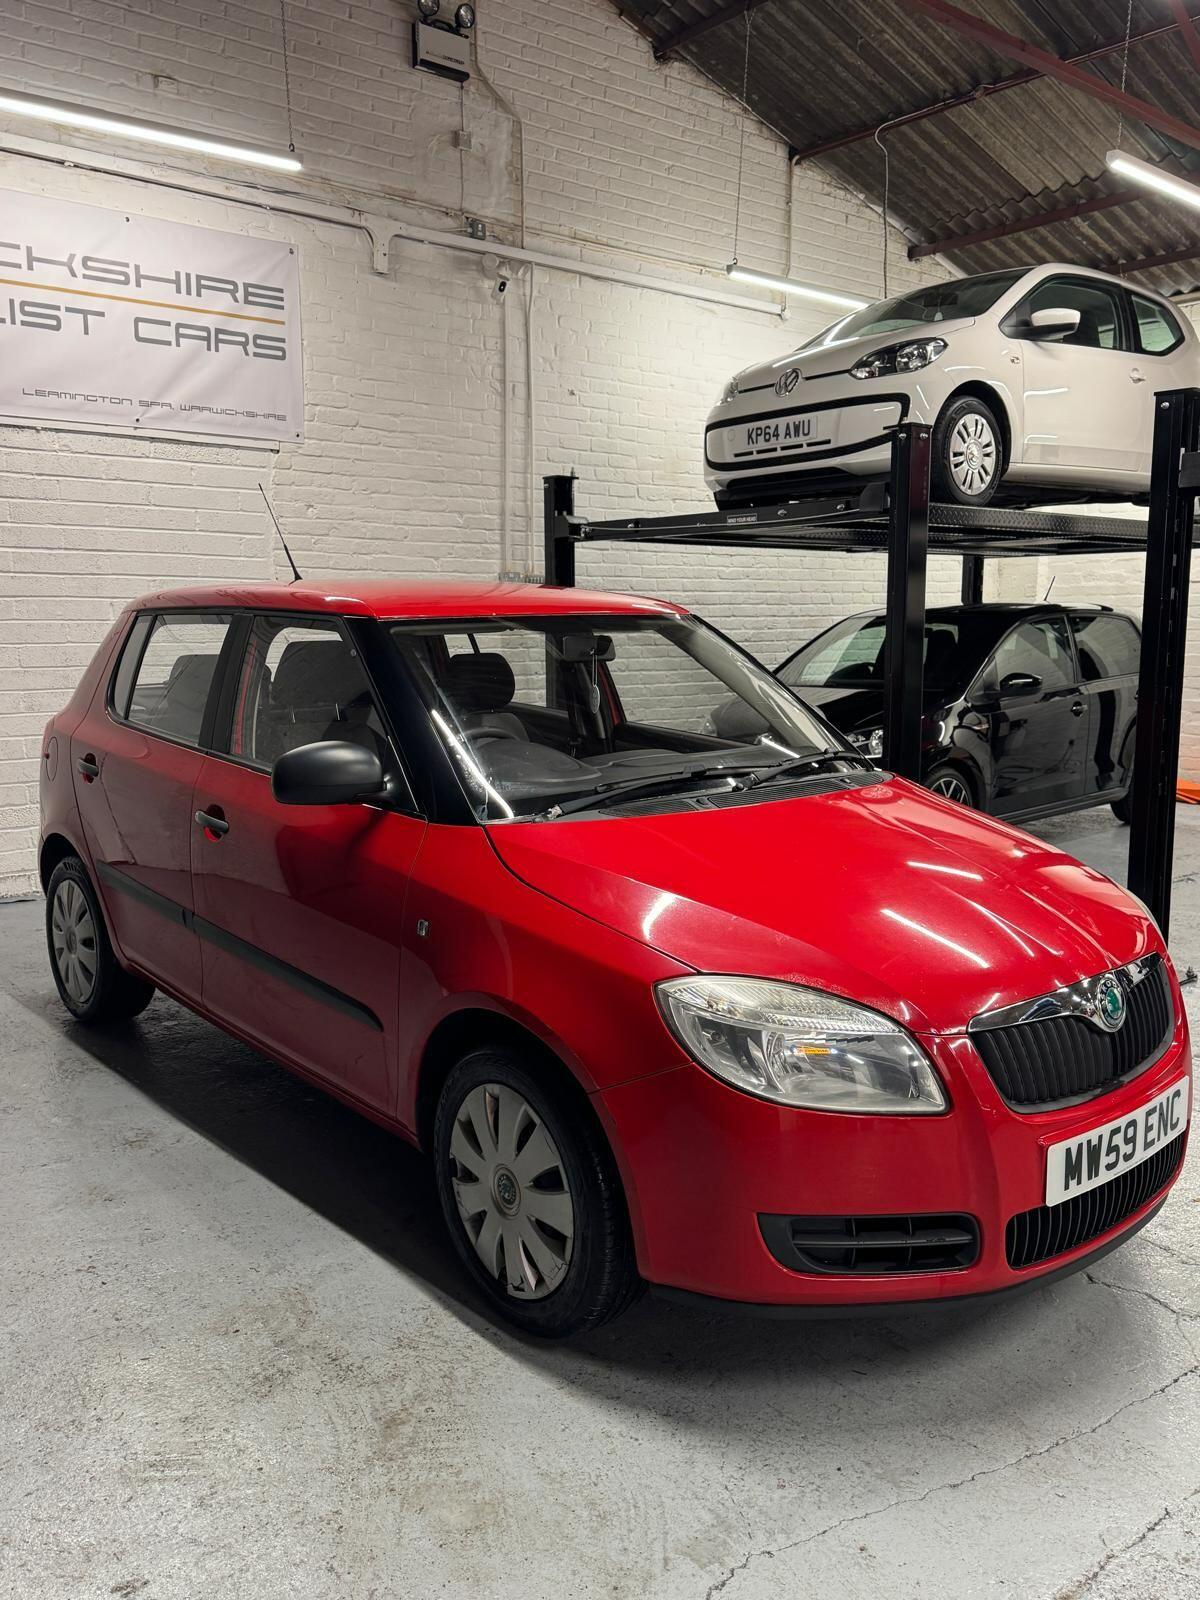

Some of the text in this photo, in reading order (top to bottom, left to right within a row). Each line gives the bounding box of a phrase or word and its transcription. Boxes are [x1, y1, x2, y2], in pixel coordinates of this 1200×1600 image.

[0, 298, 287, 361] IST CARS
[22, 387, 288, 421] LEAMINGTON SPA, WARWICKSHIRE
[747, 419, 811, 446] KP64 AWU
[1064, 1089, 1181, 1192] MW59 ENC
